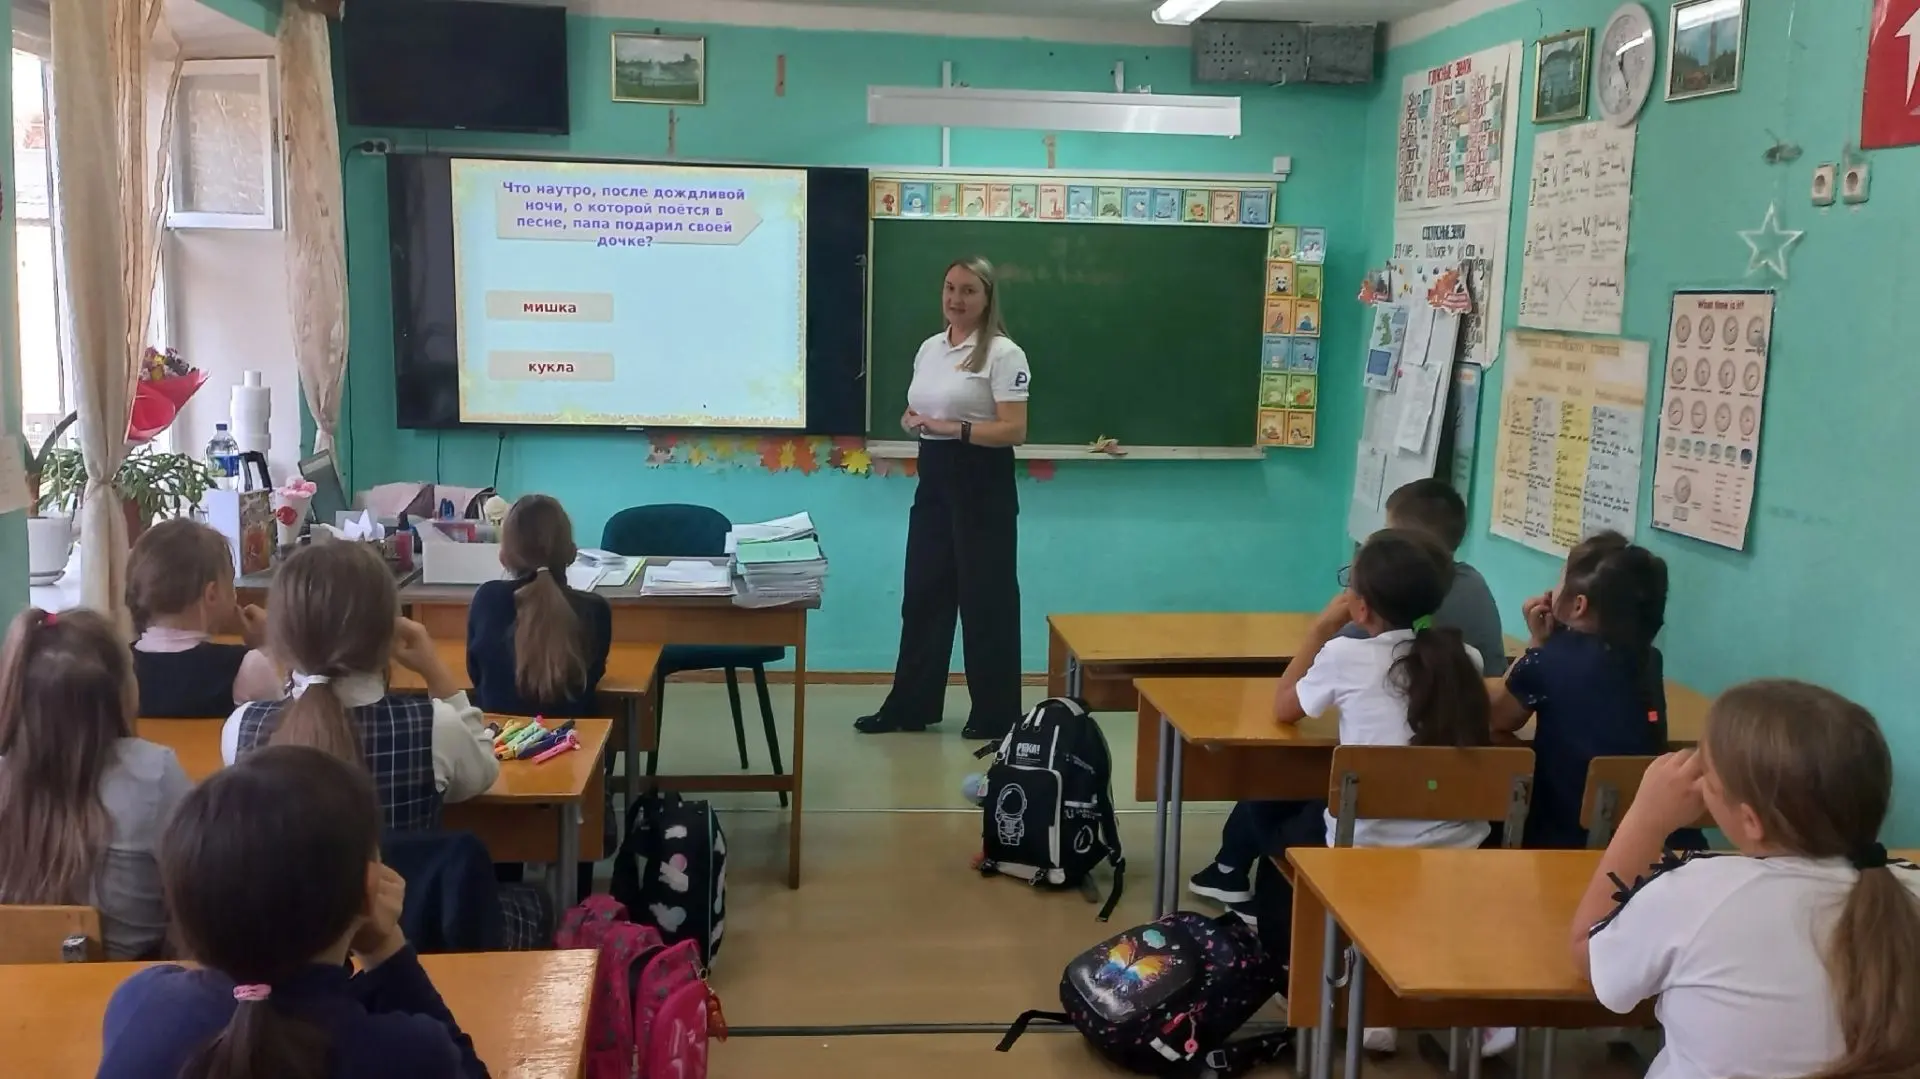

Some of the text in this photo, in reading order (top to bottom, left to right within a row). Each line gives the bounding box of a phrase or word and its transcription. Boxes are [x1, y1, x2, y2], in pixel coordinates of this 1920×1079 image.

[503, 182, 745, 200] Что наутро, после дождливой
[526, 201, 723, 216] ночи, о которой поётся в
[517, 217, 732, 233] песне, папа подарил своей
[597, 235, 653, 247] дочке?
[523, 303, 577, 313] мишка
[528, 363, 574, 375] кукла
